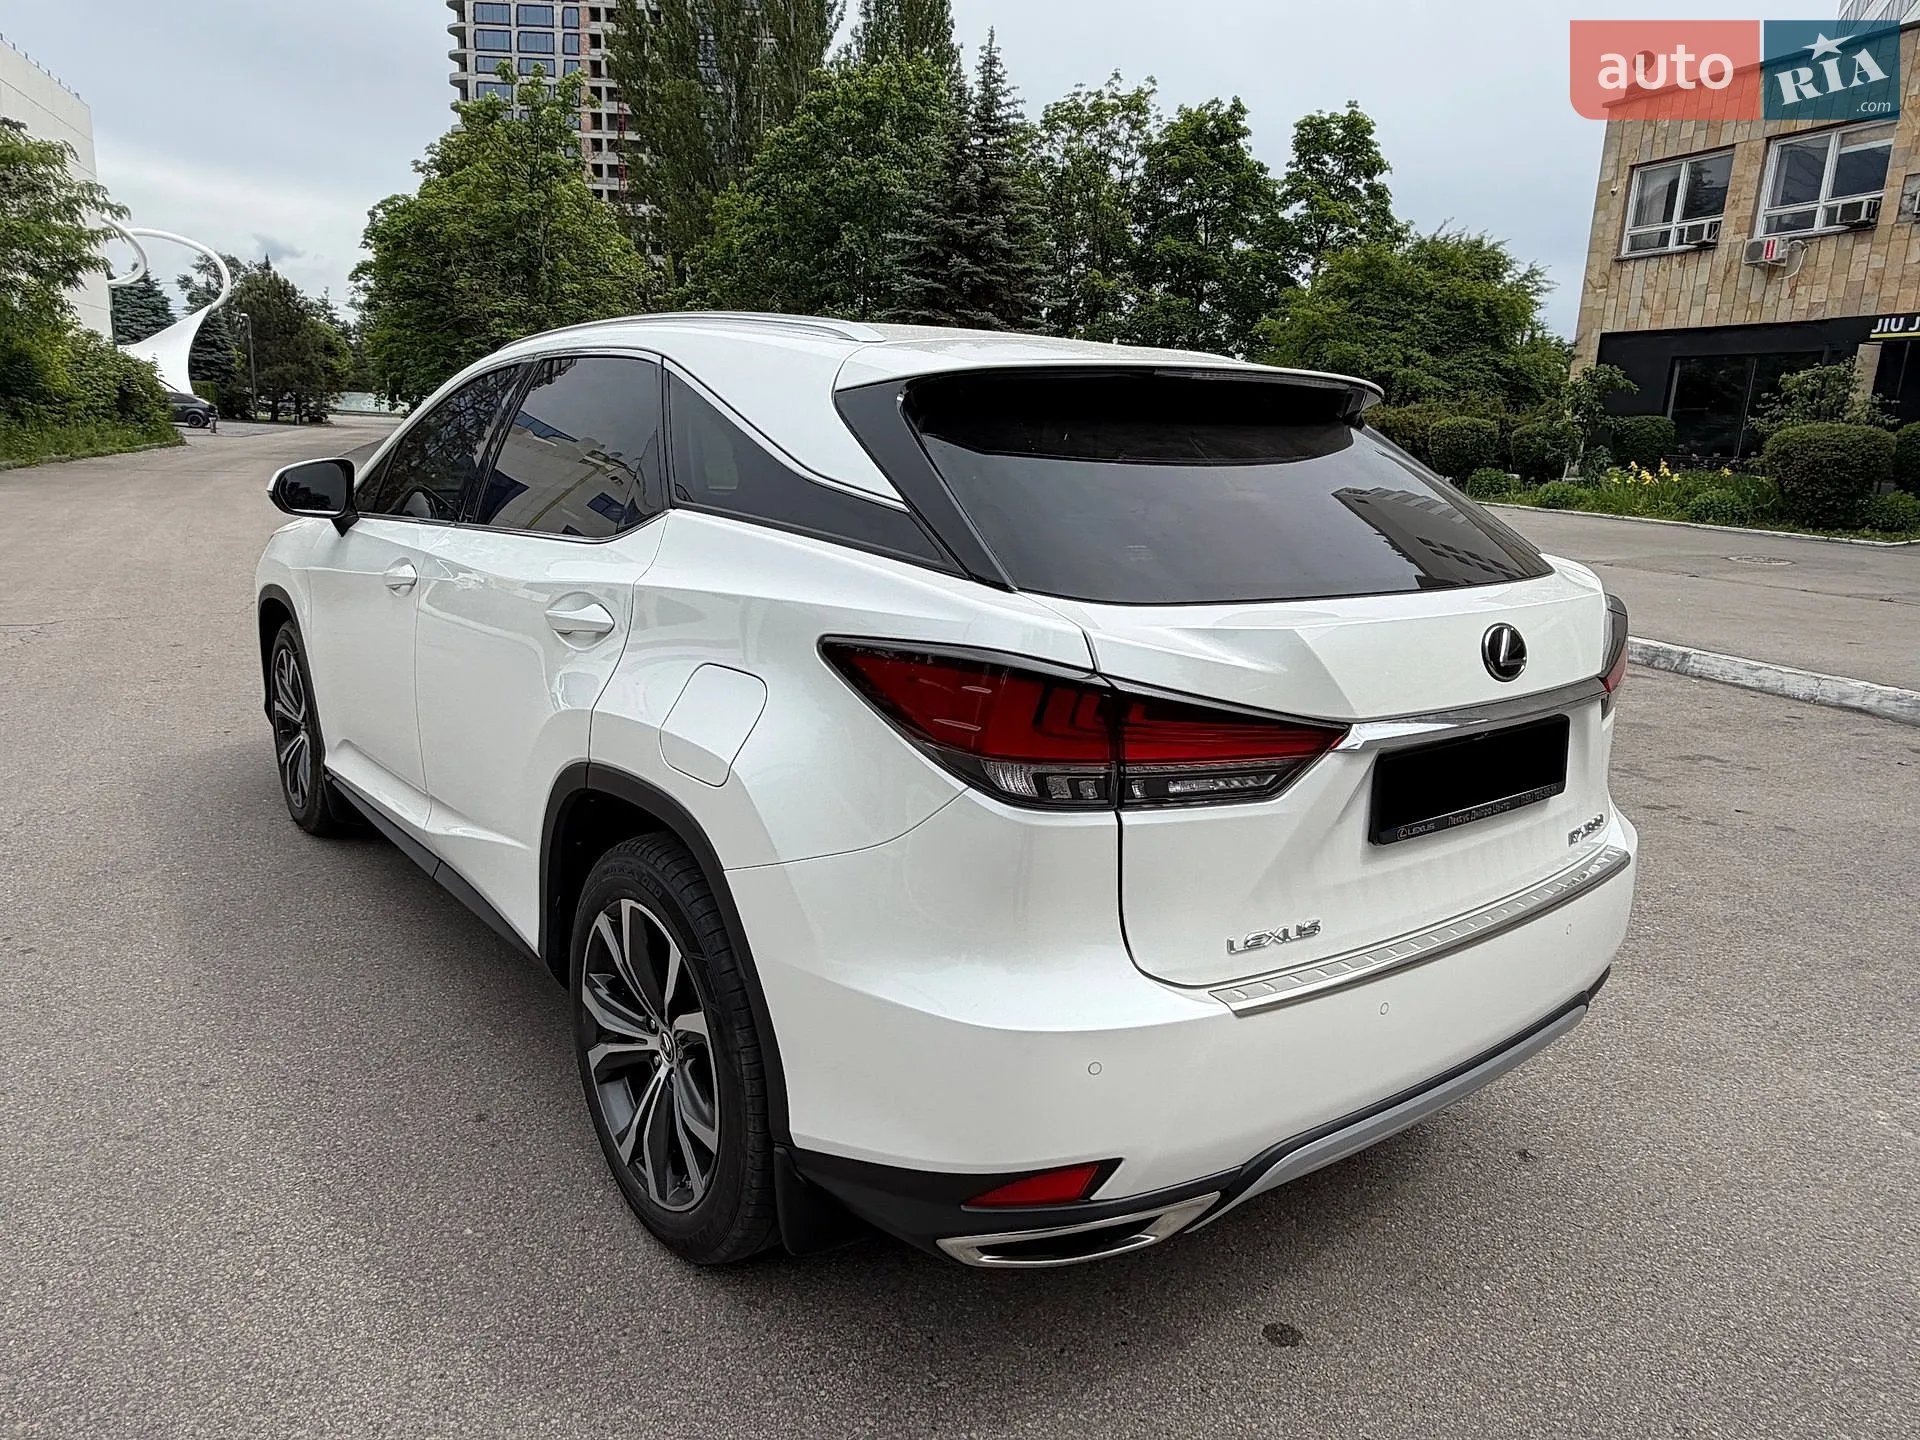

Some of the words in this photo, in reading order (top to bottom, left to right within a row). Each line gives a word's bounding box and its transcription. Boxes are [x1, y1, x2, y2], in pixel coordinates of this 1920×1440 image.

[1871, 317, 1905, 333] JIU
[1407, 822, 1435, 836] LEXUS
[1226, 919, 1321, 954] LEXUS
